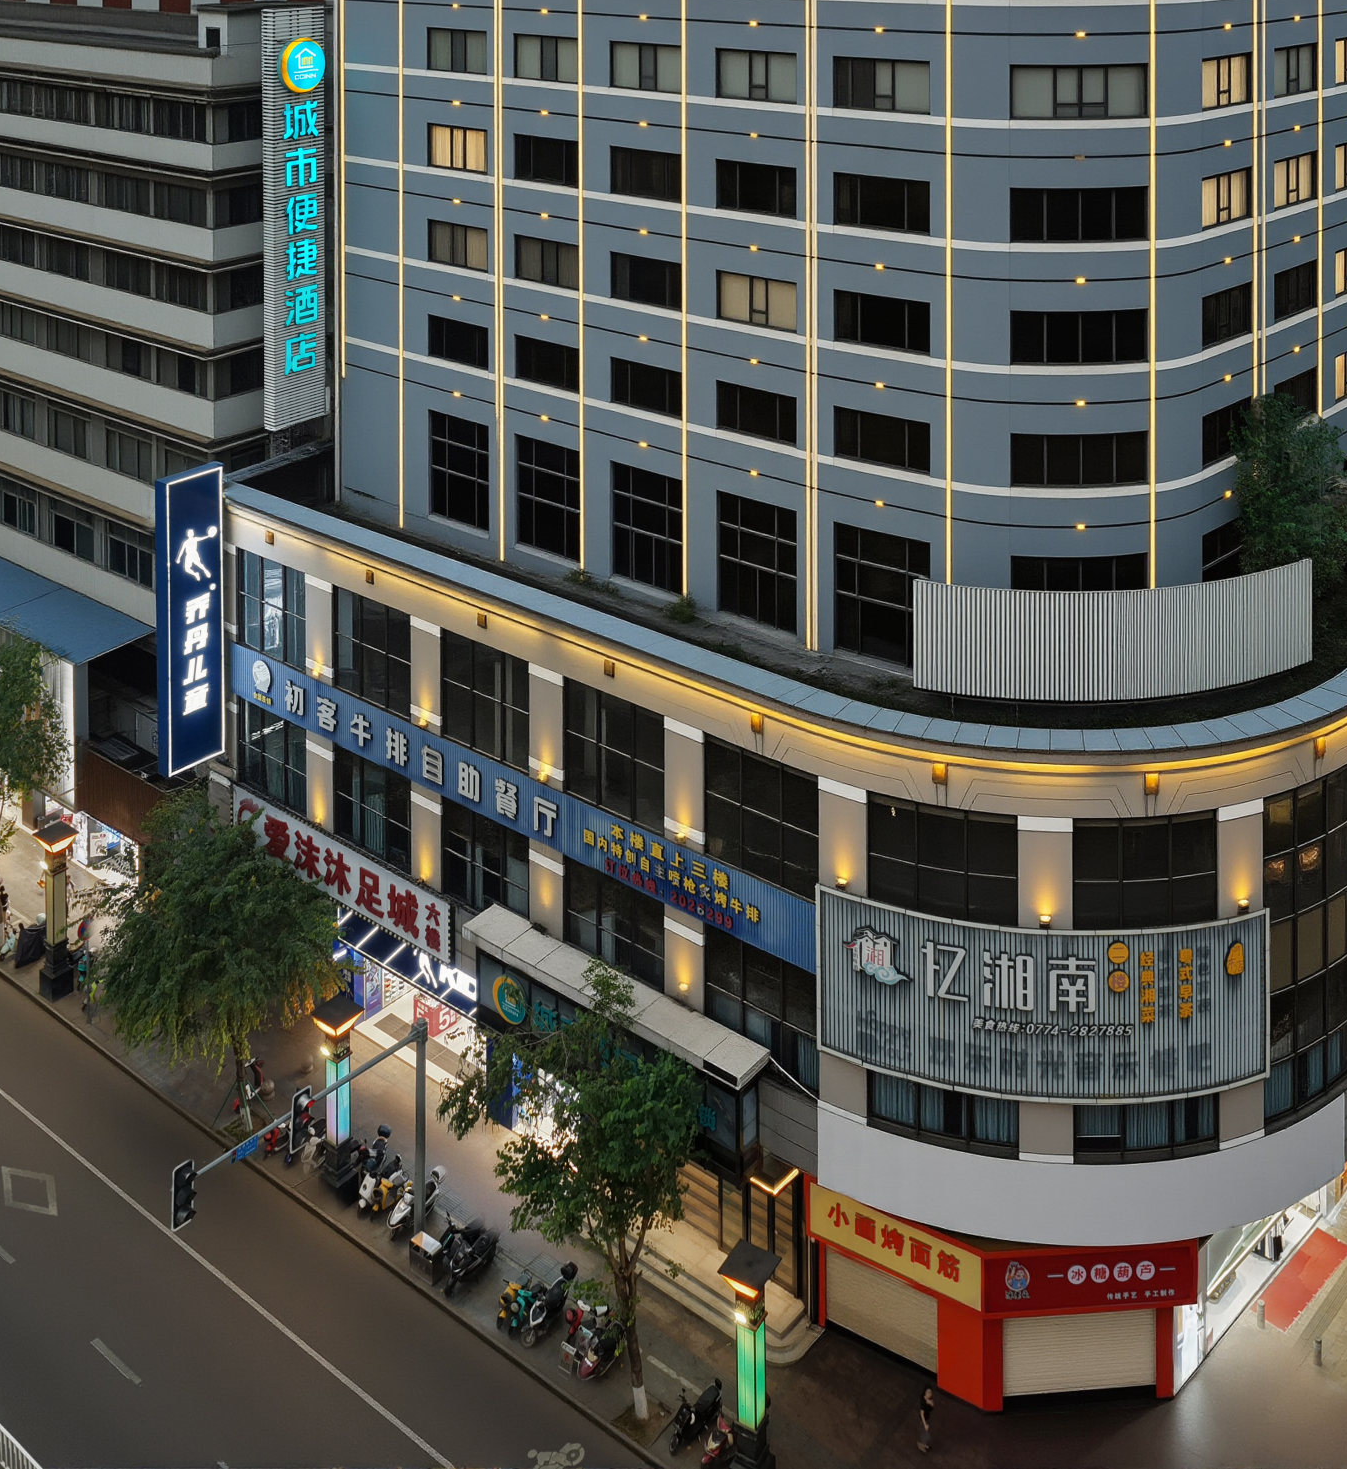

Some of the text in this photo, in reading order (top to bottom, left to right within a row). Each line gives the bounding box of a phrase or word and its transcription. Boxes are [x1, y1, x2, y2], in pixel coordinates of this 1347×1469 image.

[283, 99, 319, 377] 城市便捷酒店
[183, 592, 210, 716] 乔丹儿童
[284, 679, 558, 838] 初客牛排自助餐厅
[610, 823, 730, 890] 本楼直上三楼
[973, 1016, 1134, 1037] 美食热线:0774-2827885
[827, 1202, 961, 1283] 小画烤面筋
[1069, 1261, 1154, 1285] 冰糖葫芦
[1144, 1288, 1175, 1298] 手工制作
